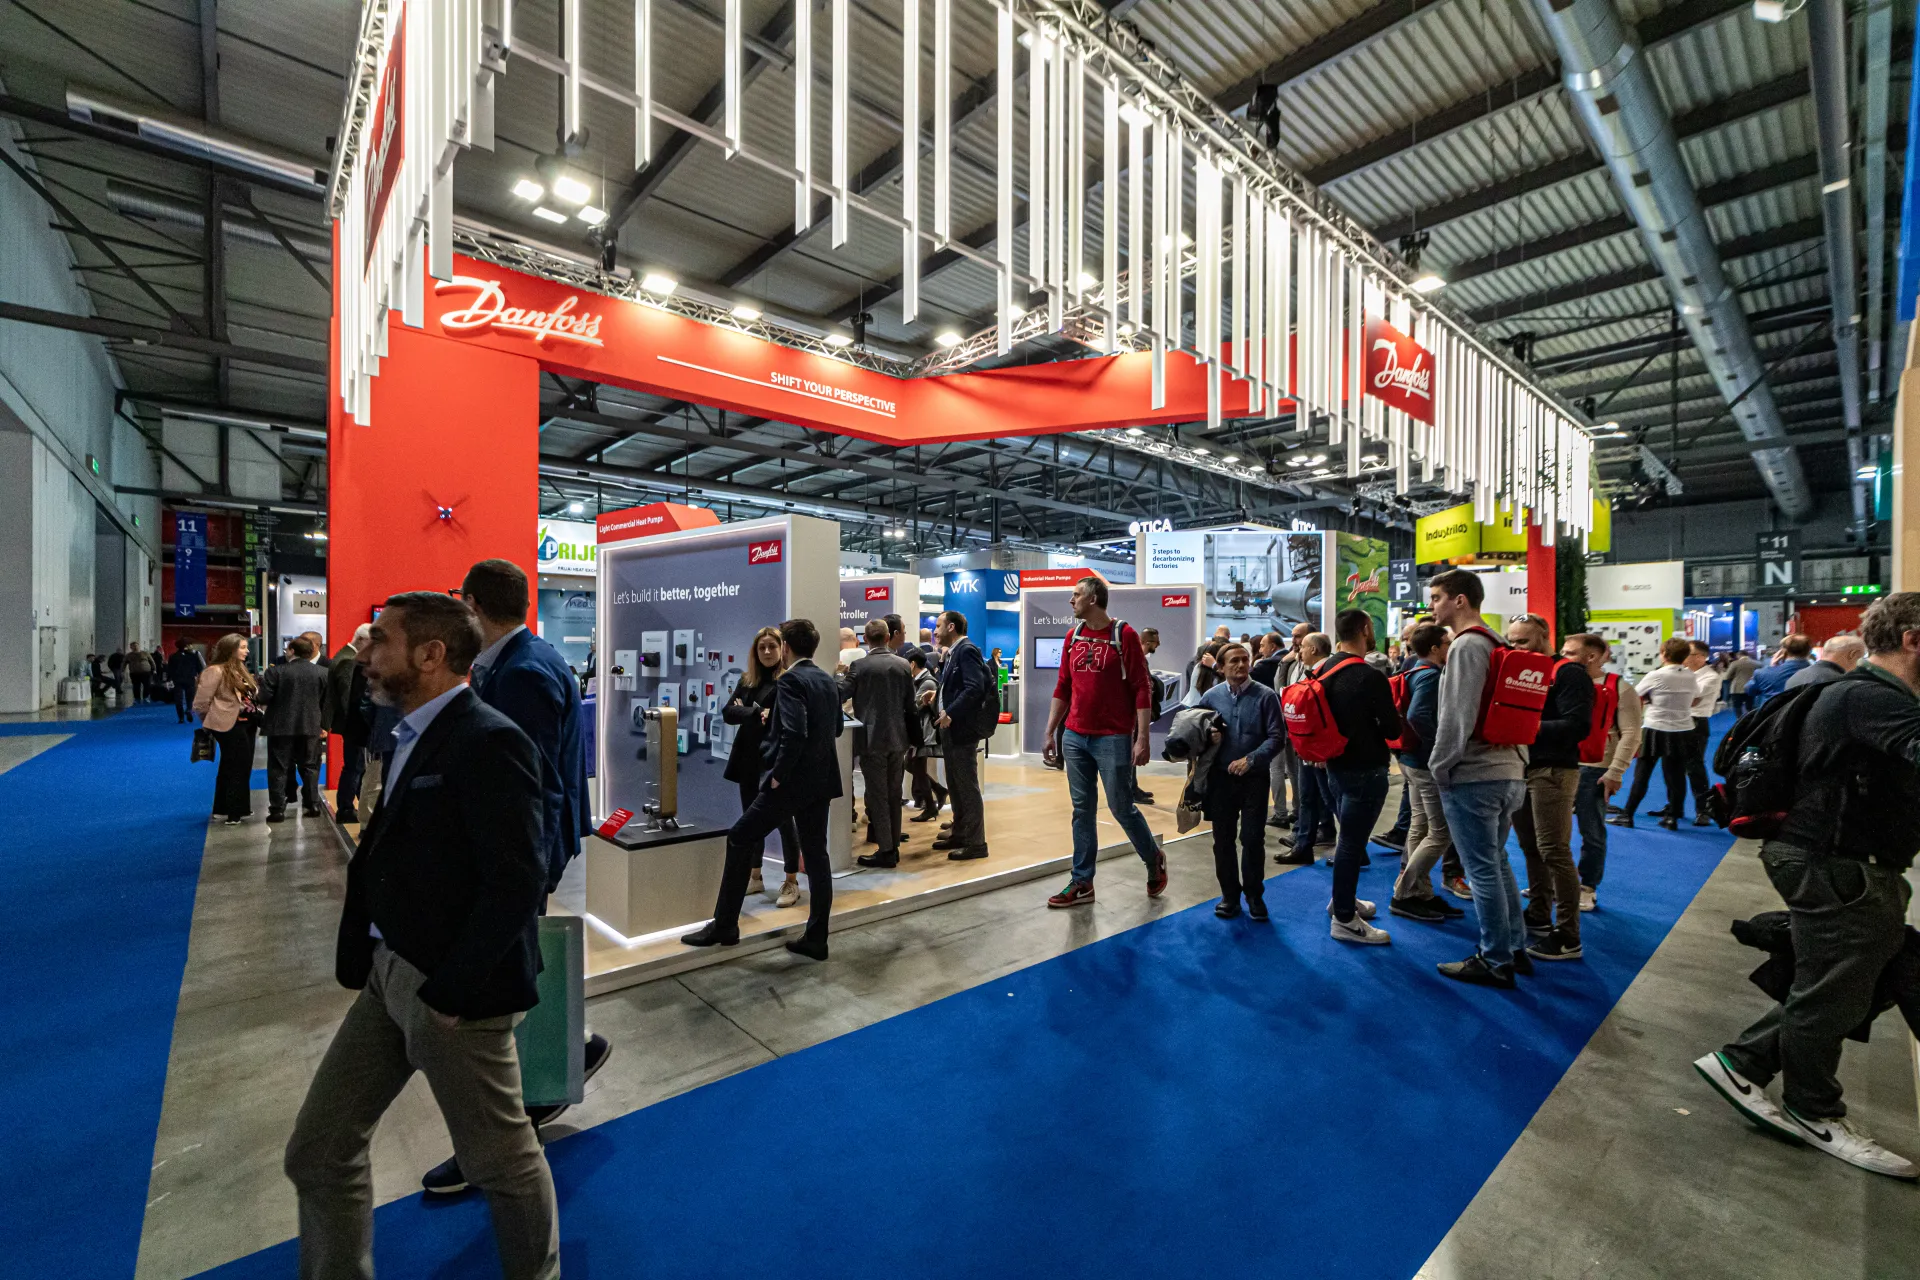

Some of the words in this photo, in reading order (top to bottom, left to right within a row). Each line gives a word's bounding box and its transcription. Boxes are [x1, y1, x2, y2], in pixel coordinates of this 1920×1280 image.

[434, 275, 604, 346] Danfoss
[1372, 338, 1431, 400] Danfoss
[770, 372, 802, 389] SHIFT
[803, 380, 833, 397] YOUR
[834, 387, 896, 412] PERSPECTIVE
[178, 519, 198, 533] 11
[599, 525, 611, 534] Light
[610, 520, 636, 531] Commercial
[636, 518, 647, 527] Heat
[647, 516, 664, 524] Pumps
[1140, 518, 1172, 532] TICA
[1771, 535, 1788, 548] 11
[751, 543, 779, 562] Danfoss
[1399, 563, 1410, 573] 11
[1765, 560, 1793, 585] N
[613, 591, 630, 605] Let's
[631, 588, 651, 603] build
[653, 589, 659, 602] it
[660, 587, 692, 601] better,
[694, 582, 740, 602] together
[867, 588, 887, 600] Danfoss
[950, 579, 980, 594] WTK
[1395, 582, 1411, 600] P
[300, 600, 320, 609] P40
[1164, 596, 1187, 606] Danfoss
[1033, 616, 1051, 625] Let's
[1052, 616, 1073, 625] build
